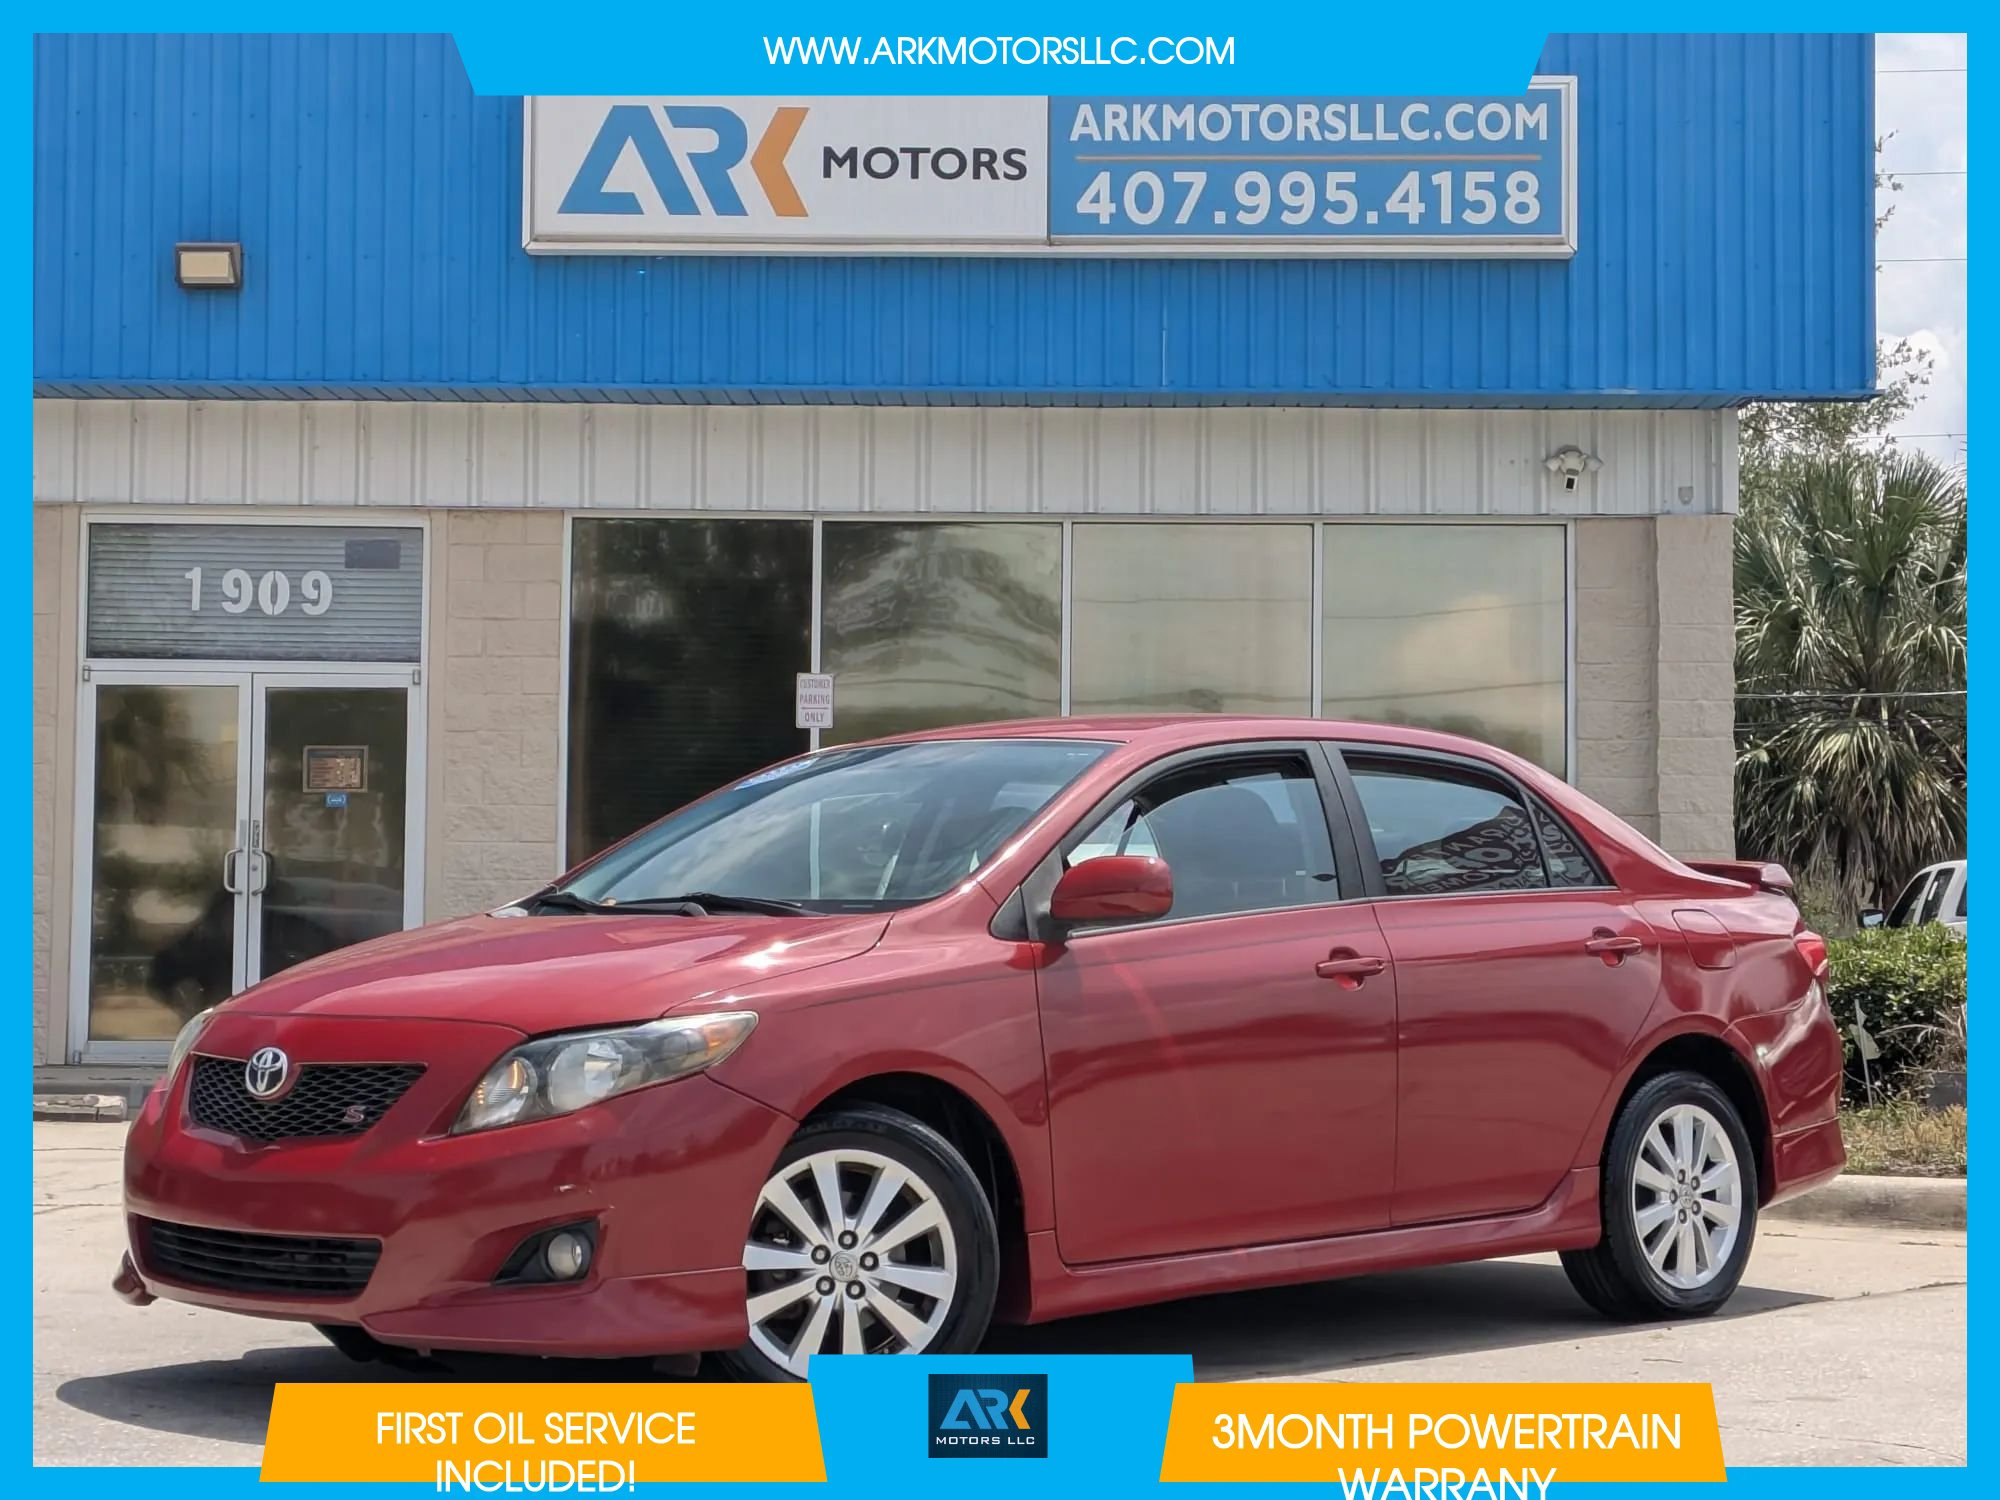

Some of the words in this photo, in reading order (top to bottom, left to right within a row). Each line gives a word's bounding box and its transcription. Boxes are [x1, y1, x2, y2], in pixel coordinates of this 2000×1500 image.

[1070, 103, 1549, 142] ARKMOTORSLLC.COM
[557, 105, 810, 218] ARK
[822, 145, 1028, 181] MOTORS
[1076, 170, 1541, 226] 407.995.4158
[184, 566, 334, 616] 1909
[799, 693, 831, 705] PARKING
[804, 711, 825, 723] ONLY
